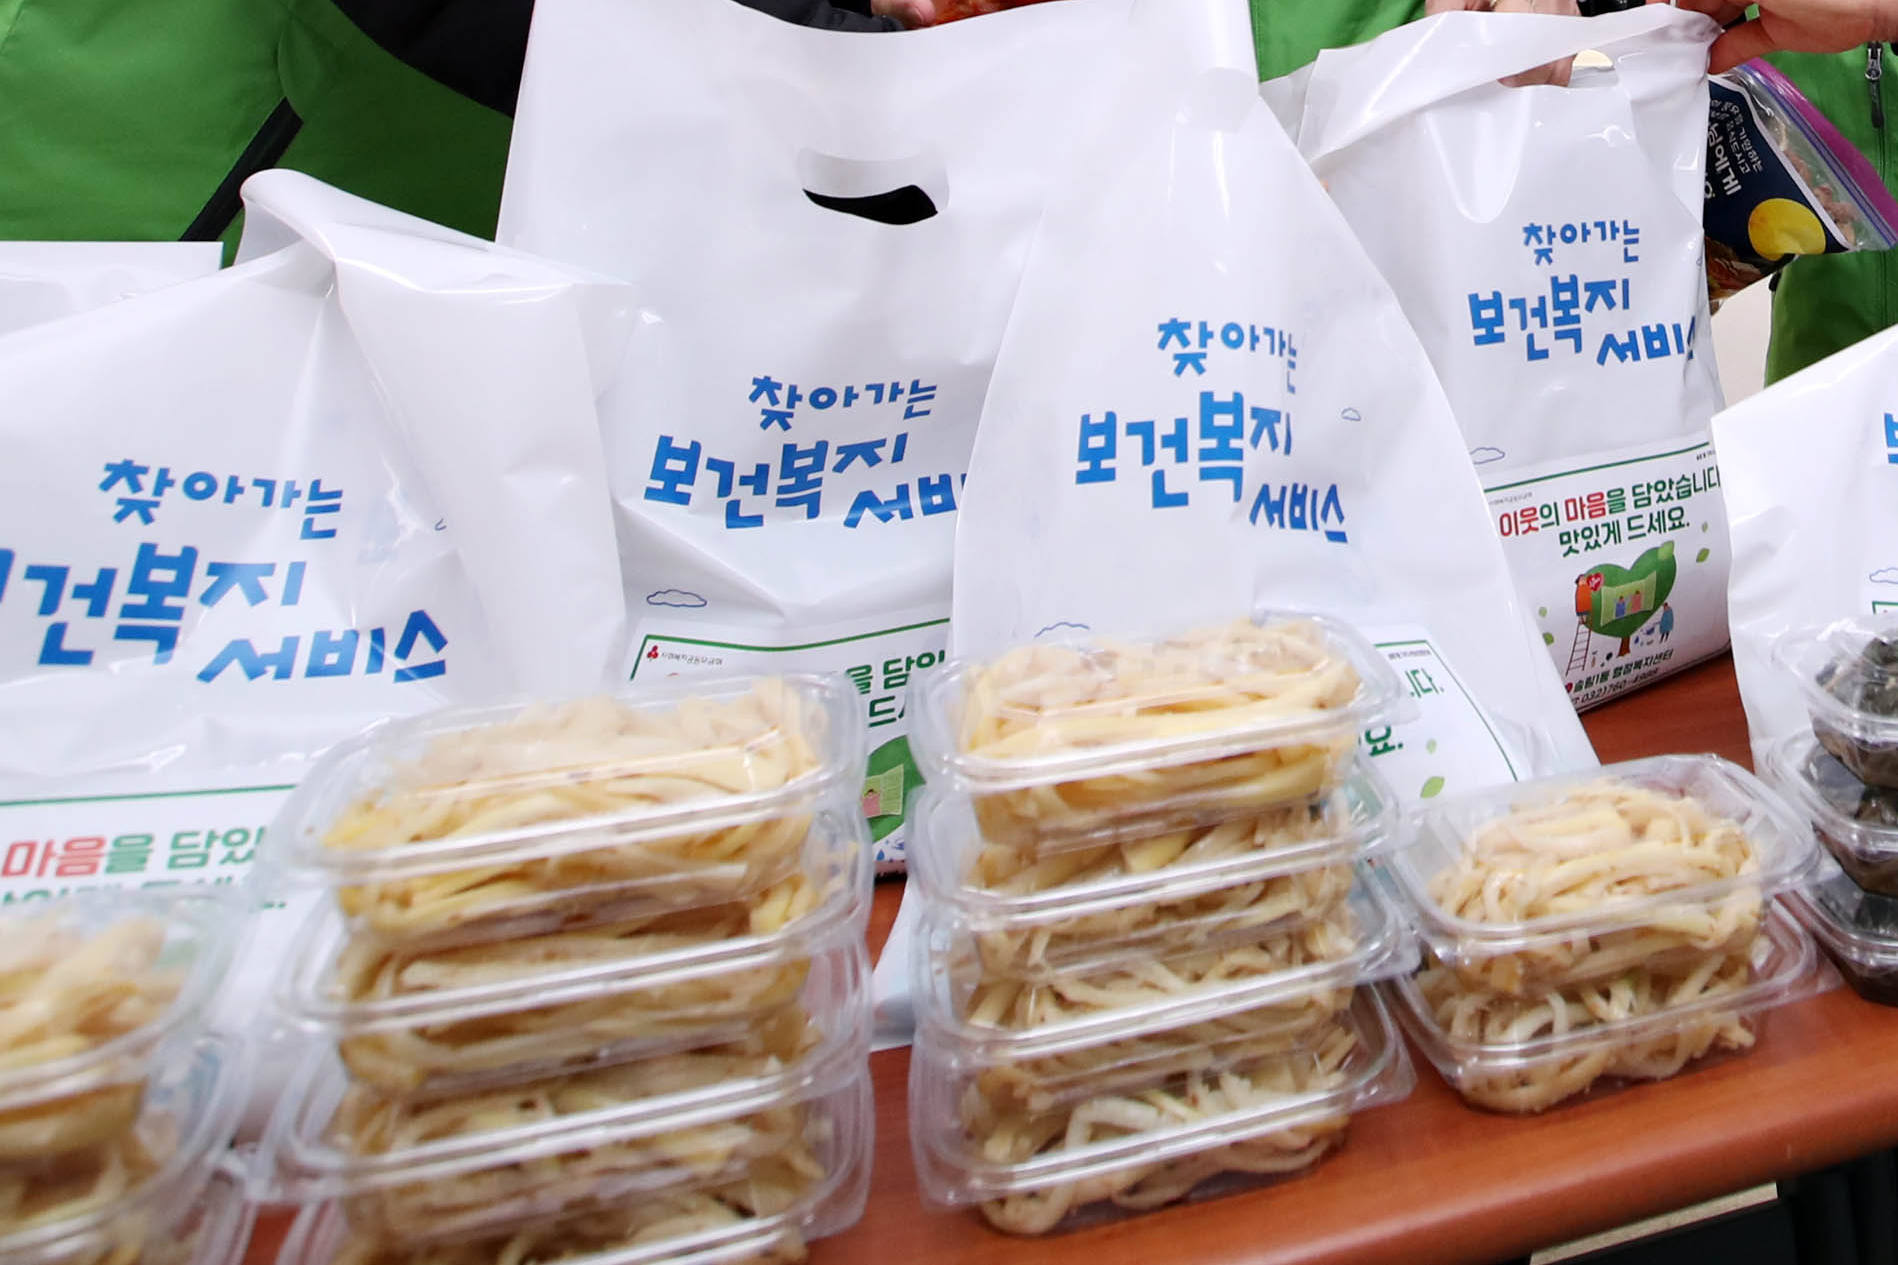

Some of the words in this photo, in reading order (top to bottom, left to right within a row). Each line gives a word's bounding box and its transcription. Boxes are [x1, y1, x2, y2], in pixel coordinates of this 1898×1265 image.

[1522, 220, 1640, 265] 찾아가는
[1467, 273, 1631, 363] 보건복지
[1596, 315, 1696, 367] 서비
[1157, 318, 1297, 394] 찾아가는
[748, 375, 937, 432] 찾아가는
[643, 431, 910, 530] 보건복지
[1075, 391, 1292, 510] 보건복지
[98, 459, 344, 541] 찾아가는
[1249, 482, 1348, 544] 서비스
[1499, 501, 1560, 538] 이웃의
[1564, 486, 1628, 523] 마음을
[1558, 519, 1622, 558] 맛있게
[1626, 505, 1691, 543] 드세요.
[0, 541, 308, 667] 건복지
[196, 609, 449, 684] 서비스
[0, 834, 154, 878] 마음을
